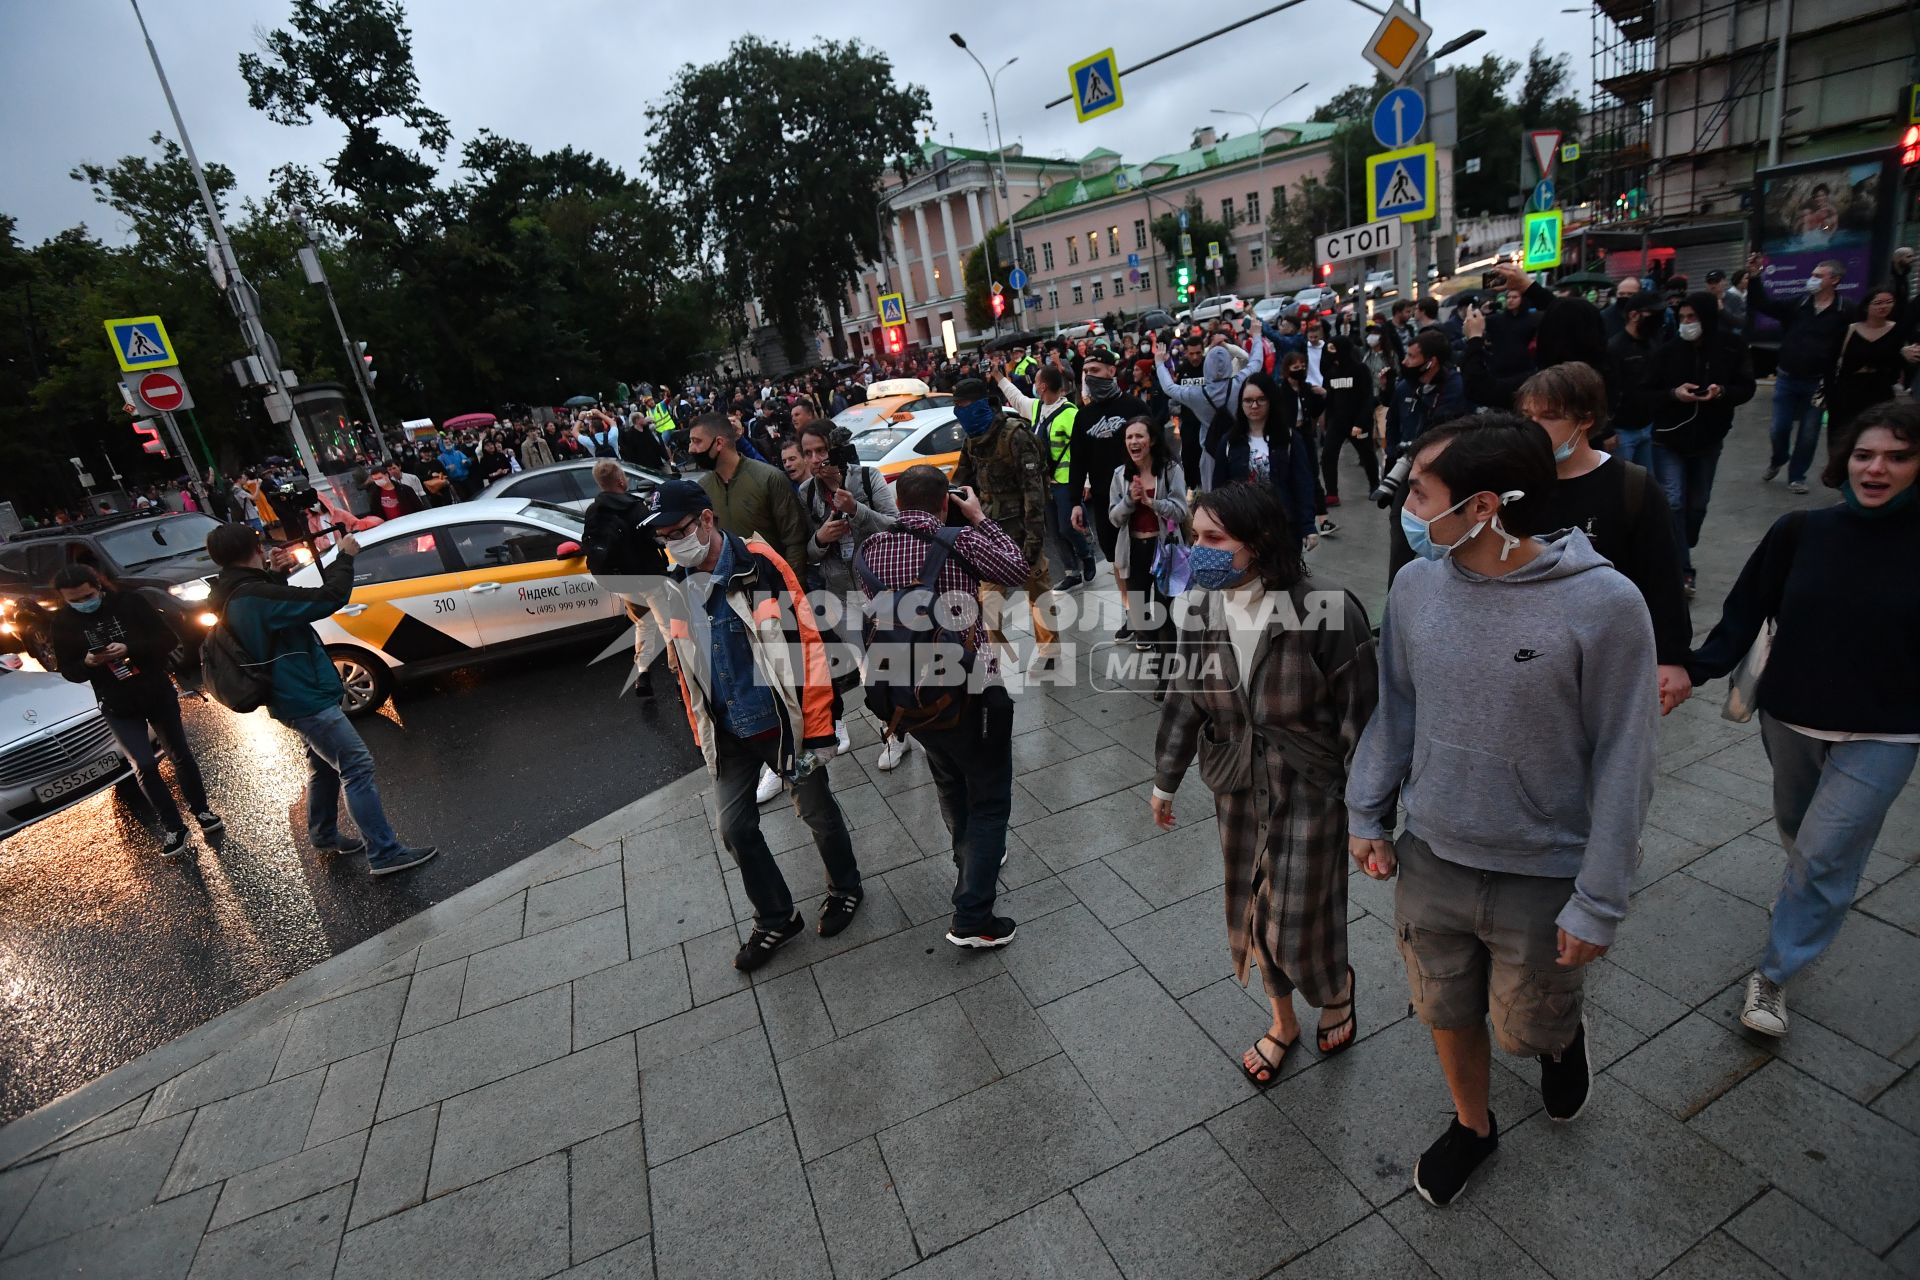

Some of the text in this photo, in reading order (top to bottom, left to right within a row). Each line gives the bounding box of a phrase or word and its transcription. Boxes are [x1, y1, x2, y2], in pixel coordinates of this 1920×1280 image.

[1327, 224, 1389, 258] СТОП
[1182, 378, 1204, 386] PARI
[518, 580, 595, 601] Яндекс Такси
[433, 598, 456, 614] 310
[537, 599, 598, 615] (495) 999 99 99
[98, 755, 114, 769] 199
